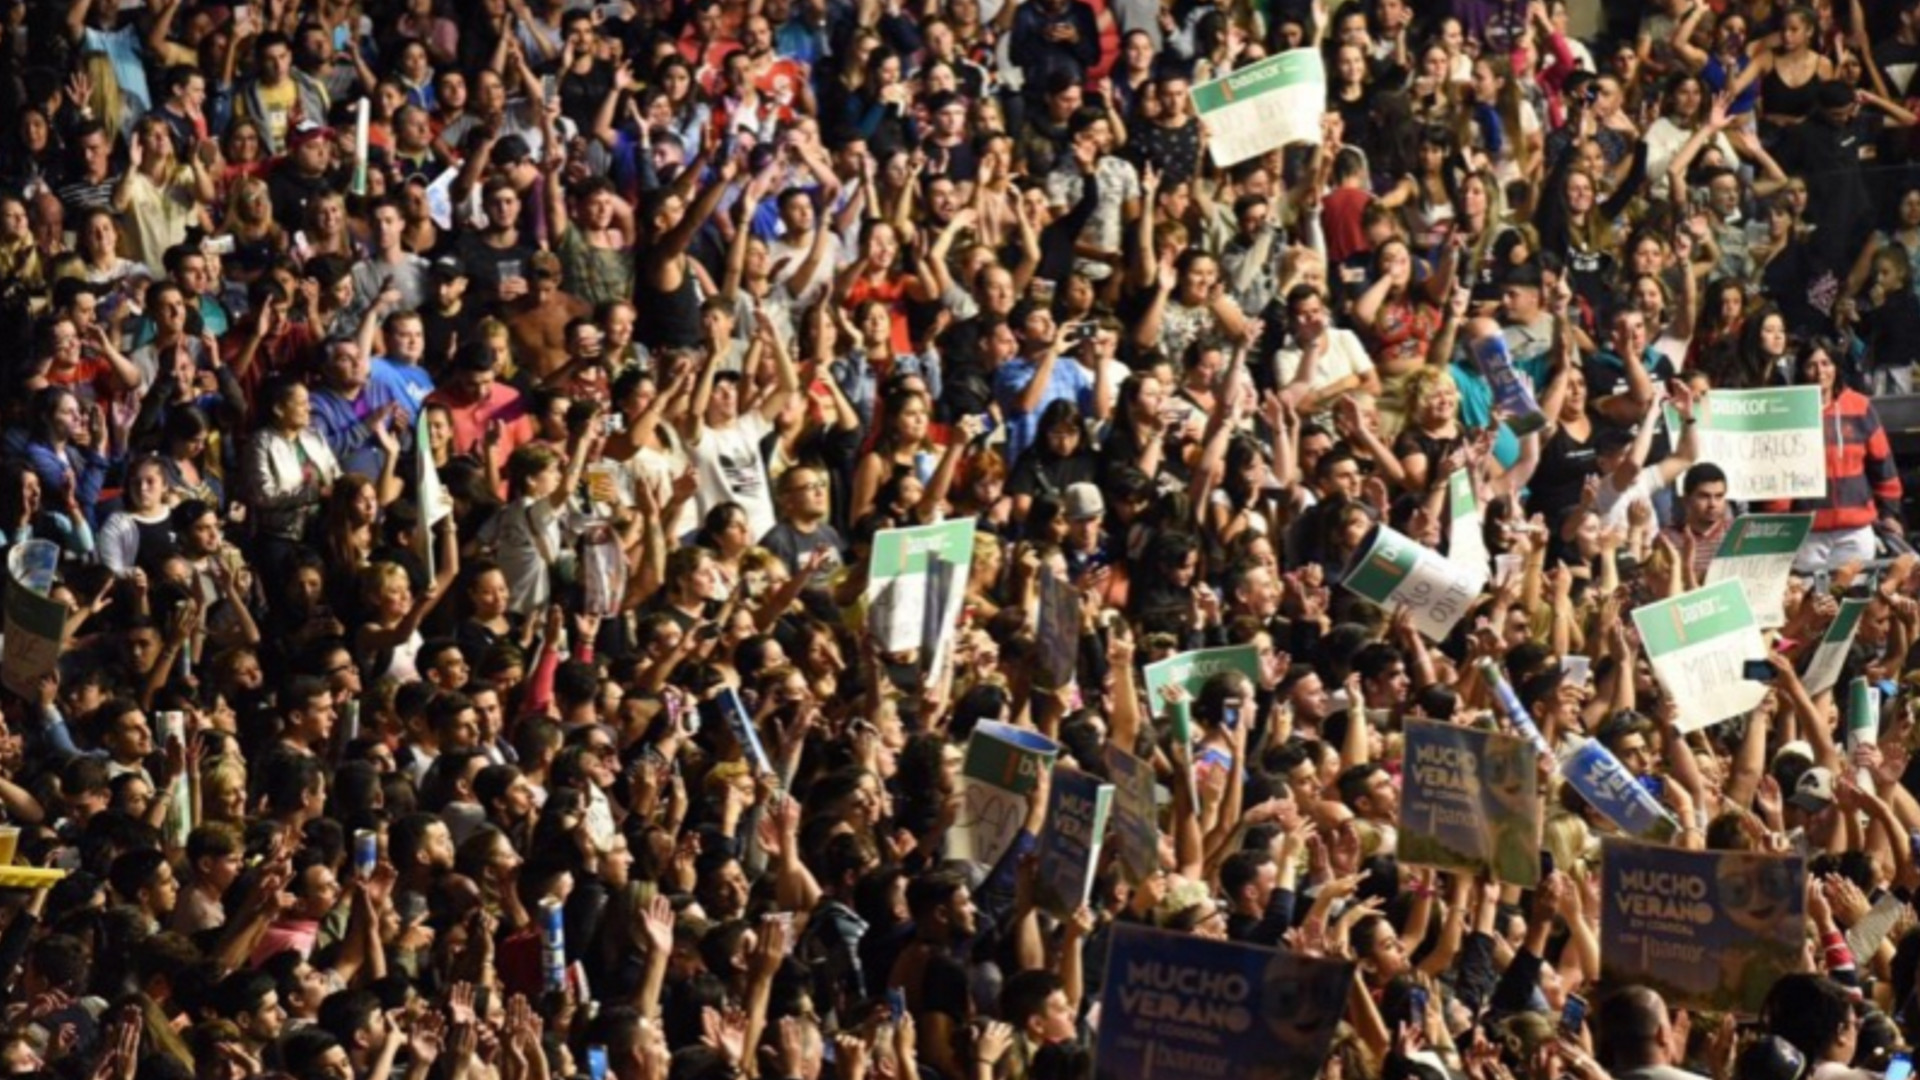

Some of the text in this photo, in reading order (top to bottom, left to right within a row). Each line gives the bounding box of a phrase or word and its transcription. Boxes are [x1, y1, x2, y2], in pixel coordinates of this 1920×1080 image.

[1619, 867, 1708, 900] MUCHO
[1613, 891, 1715, 925] VERANO
[1126, 958, 1249, 1003] MUCHO
[1116, 984, 1253, 1034] VERANO
